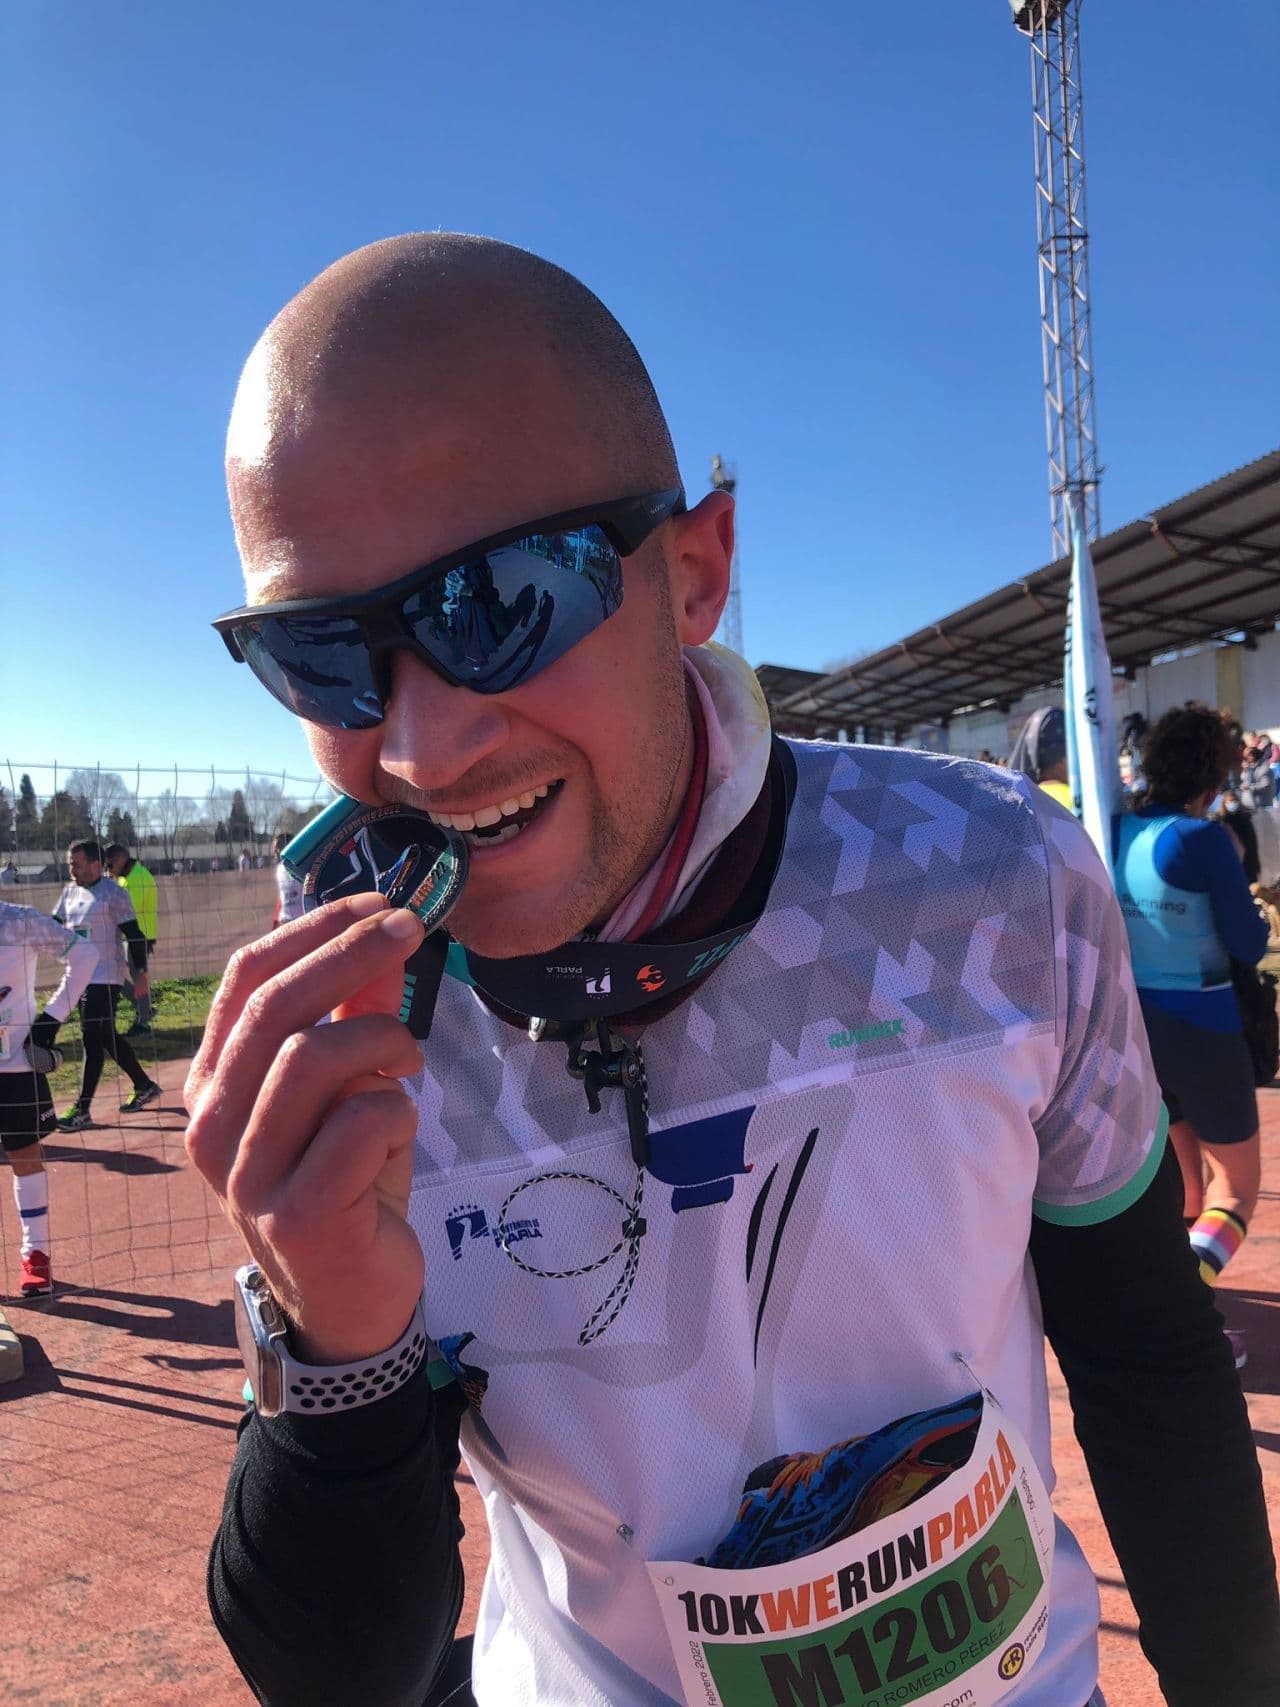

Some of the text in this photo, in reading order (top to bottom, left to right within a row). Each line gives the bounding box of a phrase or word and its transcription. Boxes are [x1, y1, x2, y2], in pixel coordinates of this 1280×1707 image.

[545, 966, 583, 974] PARLA
[759, 1543, 1011, 1707] M1206
[688, 1640, 719, 1707] Febrero 2022
[883, 1659, 957, 1704] ROMERO
